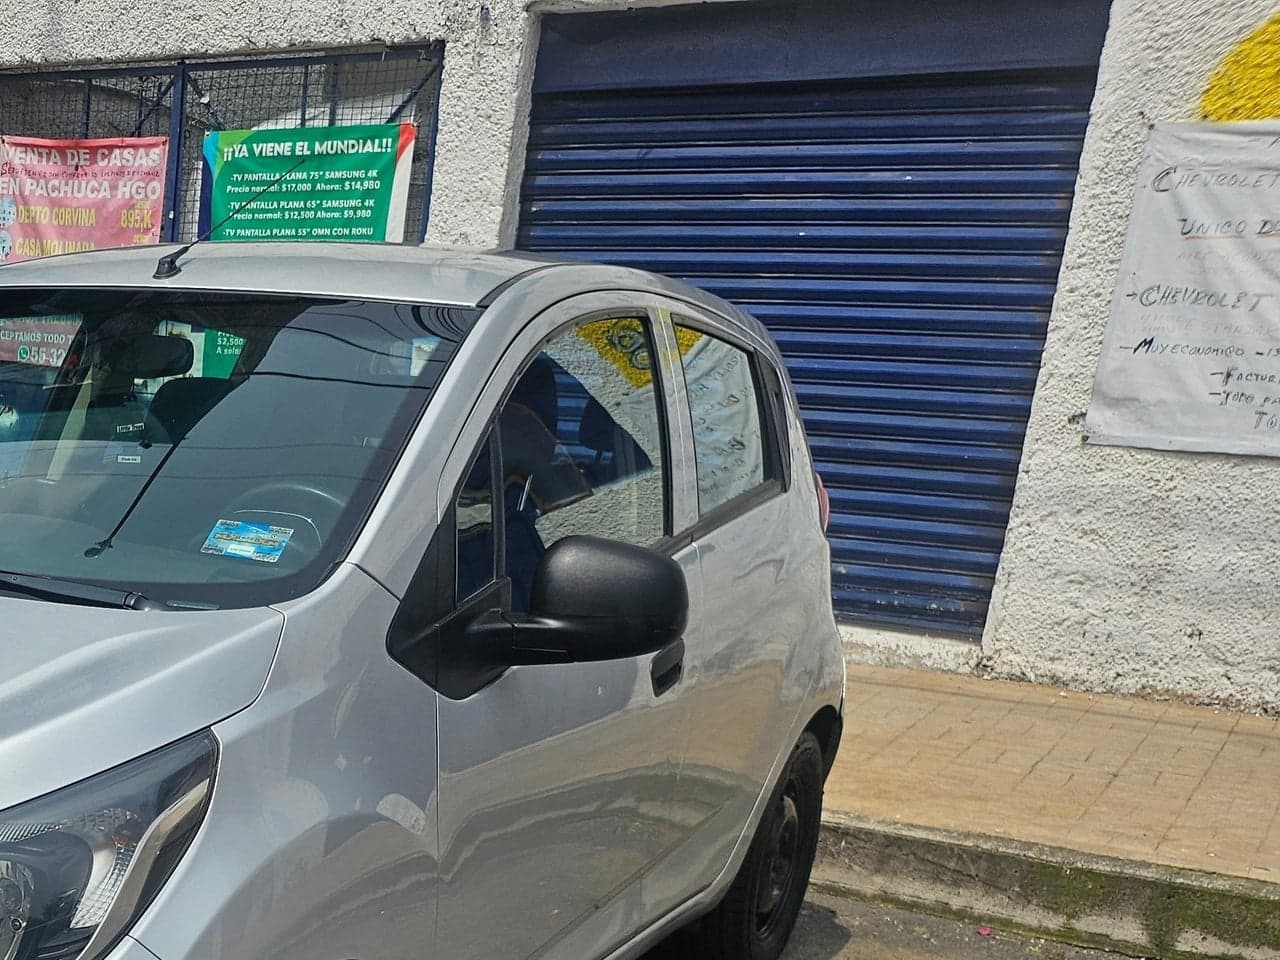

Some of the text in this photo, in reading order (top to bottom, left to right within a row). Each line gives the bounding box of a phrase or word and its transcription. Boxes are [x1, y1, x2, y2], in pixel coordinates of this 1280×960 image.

[253, 142, 292, 157] VIENE
[295, 141, 310, 156] EL
[2, 147, 160, 167] VENTA DE CASAS
[244, 173, 280, 182] PANTALLA
[325, 170, 365, 179] SAMSUNG
[367, 169, 378, 178] 4K
[24, 179, 111, 199] PACHUCA
[117, 181, 160, 200] HGO
[226, 184, 249, 193] Precio
[281, 183, 312, 192] $17,000
[315, 182, 342, 192] Ahora:
[279, 201, 304, 209] PLANA
[322, 199, 362, 208] SAMSUNG
[364, 199, 375, 207] 4K
[18, 205, 50, 225] DEPTO
[52, 207, 96, 228] CORVINA
[254, 211, 282, 220] normal:
[284, 210, 315, 220] $12,500
[316, 209, 342, 218] Ahora:
[344, 209, 371, 219] $9,980
[236, 228, 271, 237] PANTALLA
[272, 228, 296, 237] PLANA
[332, 227, 349, 236] CON
[351, 227, 374, 236] ROKU
[15, 239, 40, 257] CASA
[44, 333, 65, 345] TODO
[216, 347, 222, 355] A
